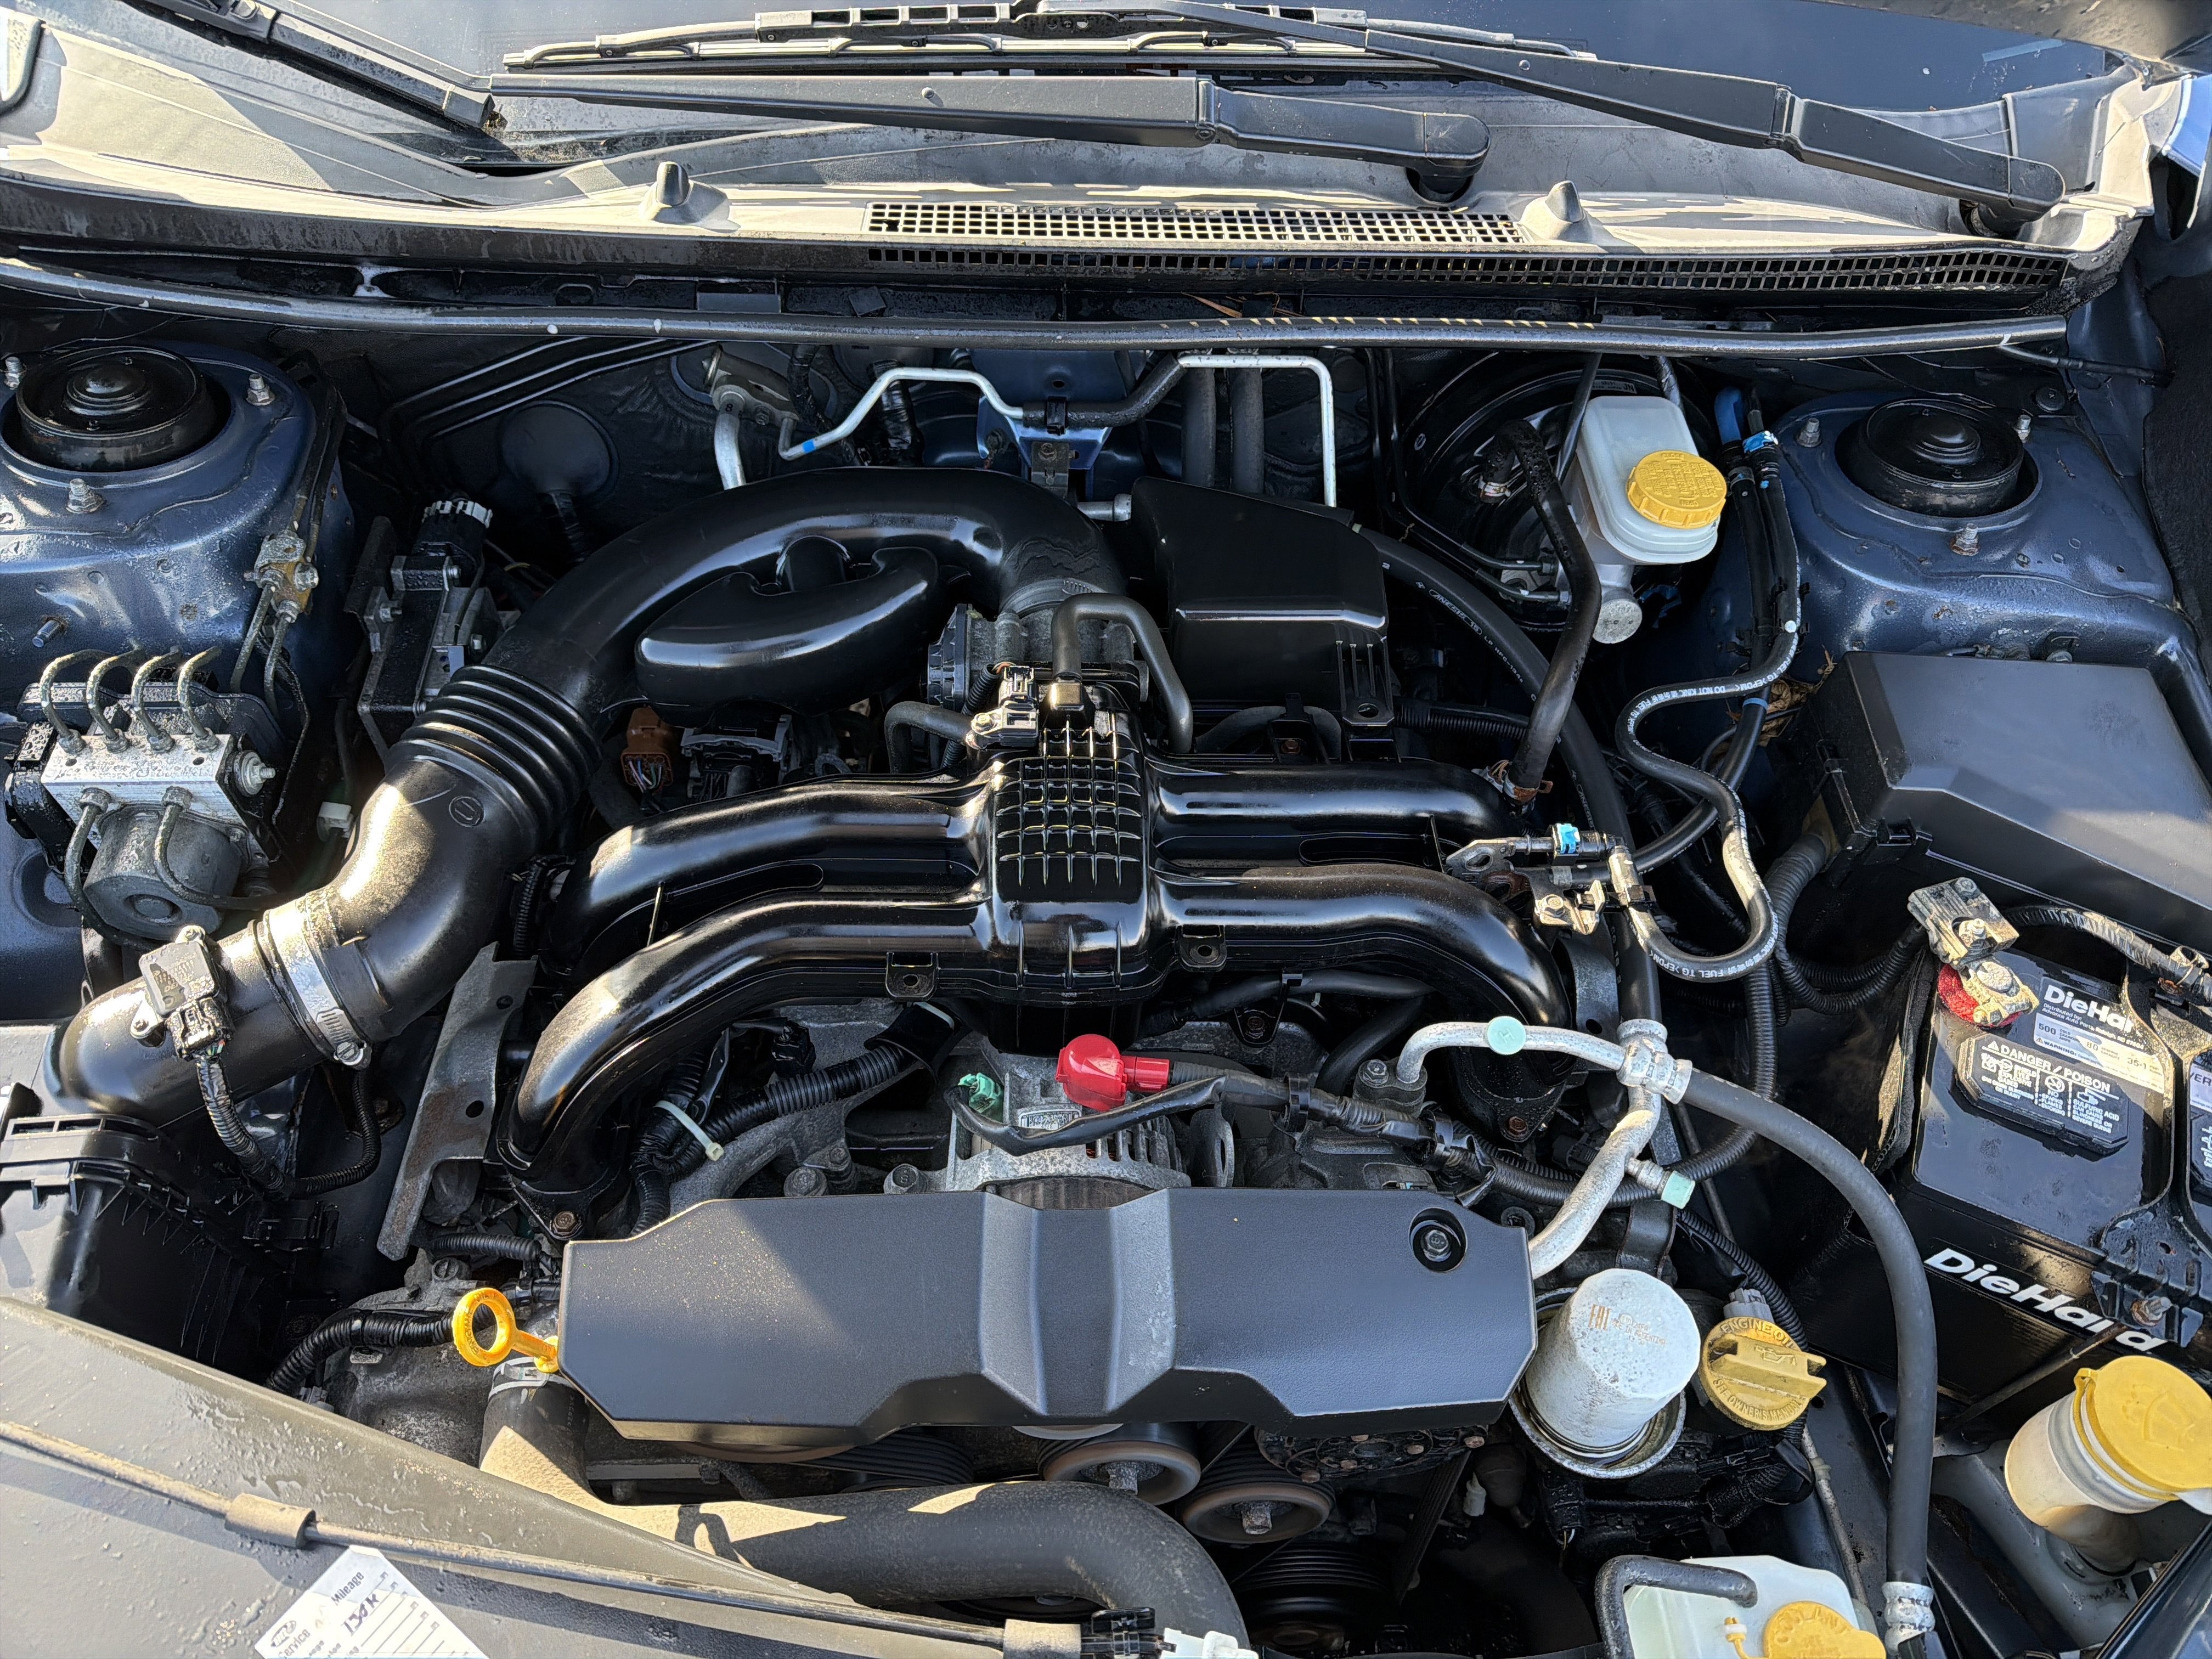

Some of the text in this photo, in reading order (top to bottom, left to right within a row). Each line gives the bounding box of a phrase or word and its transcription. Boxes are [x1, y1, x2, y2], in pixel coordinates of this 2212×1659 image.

[725, 403, 732, 413] 8
[1682, 967, 1696, 978] TG
[1698, 968, 1724, 978] FUEL
[2042, 1007, 2066, 1019] Advance
[2066, 1015, 2079, 1024] Auto
[2043, 1003, 2073, 1017] Distributed
[2039, 1023, 2056, 1035] 500
[2044, 1040, 2076, 1056] WARNING:
[2086, 1041, 2098, 1051] 80
[2001, 1044, 2052, 1071] DANGER
[2063, 1067, 2111, 1093] POISON
[2047, 1089, 2059, 1097] NO
[2041, 1098, 2063, 1110] FLAMES
[2041, 1104, 2066, 1116] SMOKING
[2073, 1098, 2119, 1121] SULFURIC ACID
[2072, 1110, 2113, 1128] BLINDNESS OR
[2073, 1105, 2103, 1120] CAN CAUSE
[2072, 1114, 2092, 1127] SEVERE
[1924, 1248, 2168, 1352] DieHard
[1720, 1319, 1795, 1349] ENGINE OIL
[1713, 1378, 1803, 1421] SEE OWNER'S MANUAL
[330, 1571, 365, 1607] Mileage
